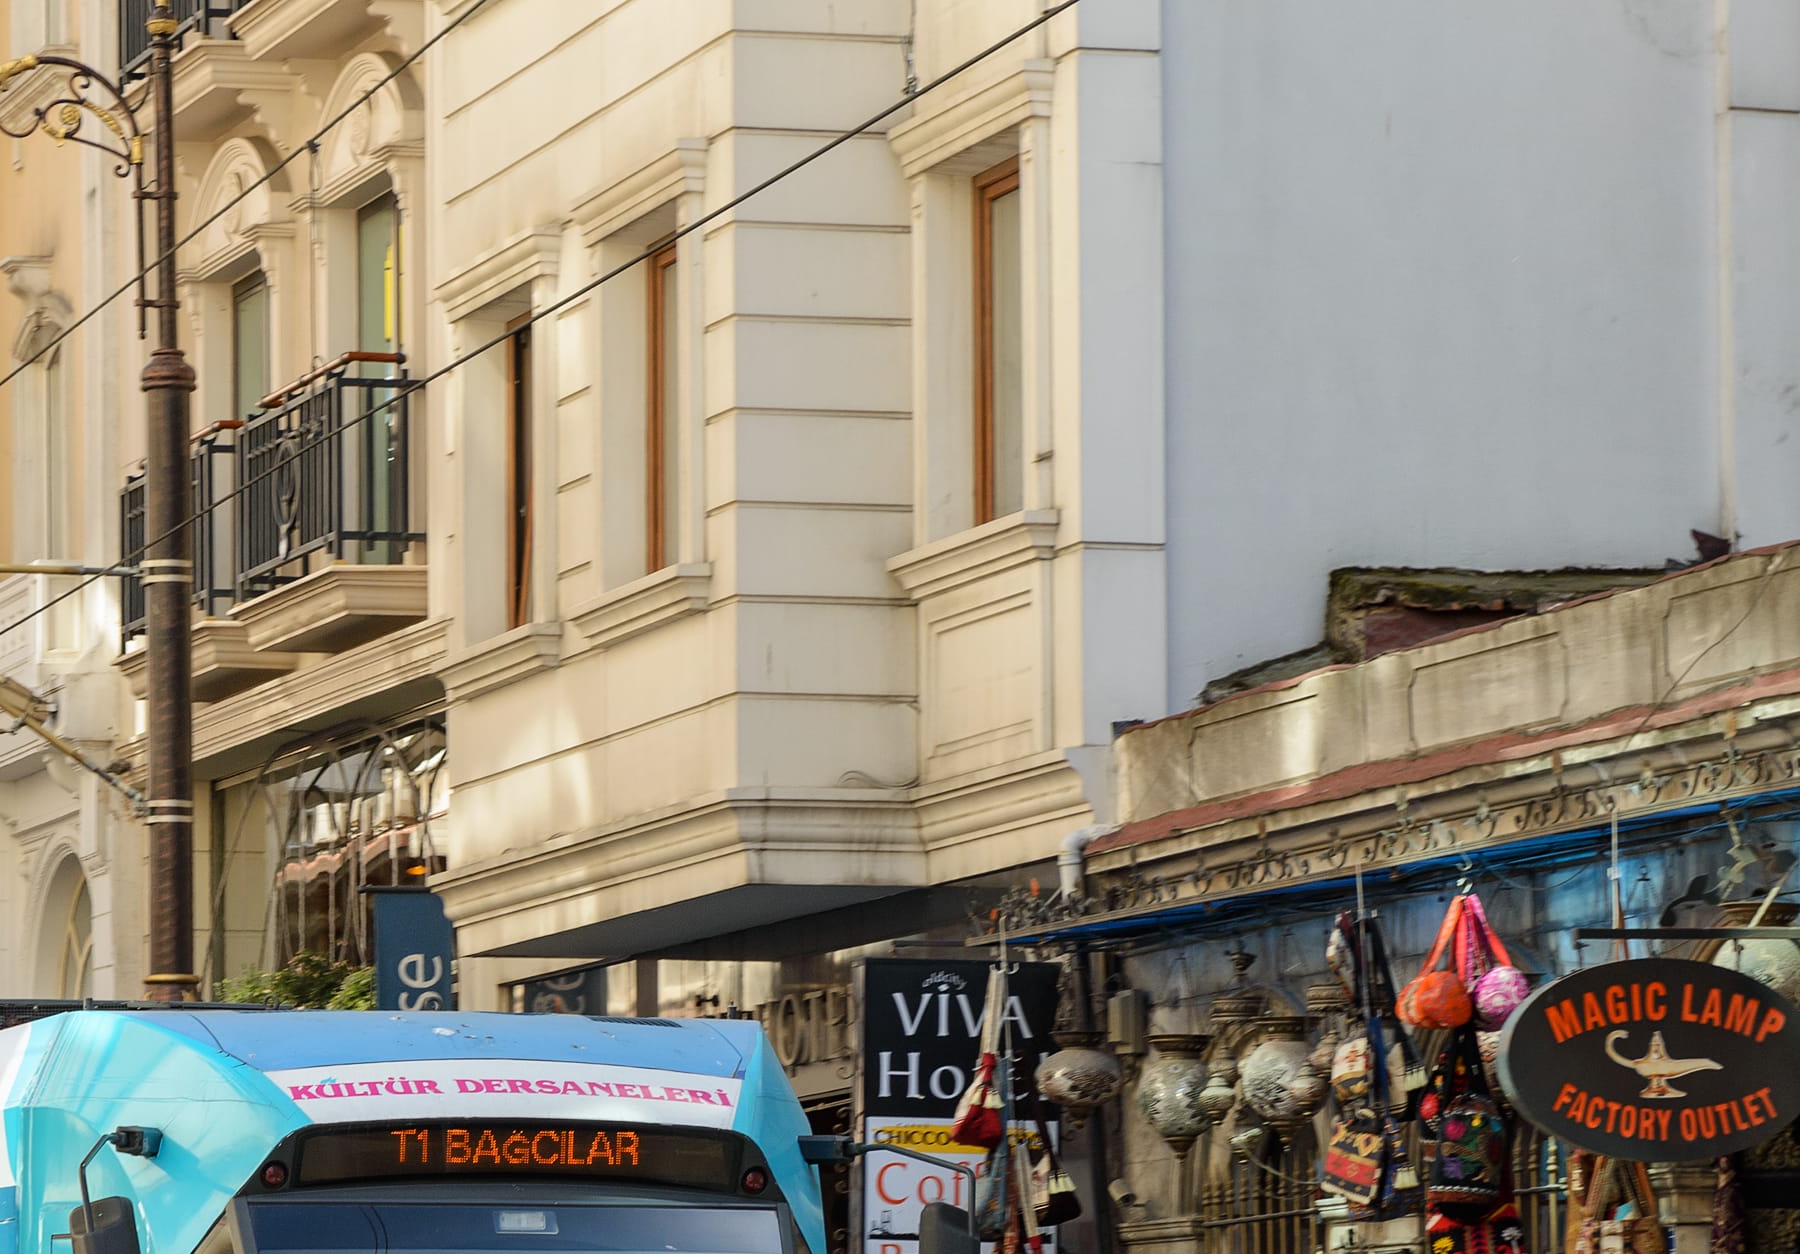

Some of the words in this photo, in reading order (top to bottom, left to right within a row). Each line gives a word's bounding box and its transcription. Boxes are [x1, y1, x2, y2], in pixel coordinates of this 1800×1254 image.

[1544, 981, 1668, 1044] MAGIC
[1680, 983, 1787, 1043] LAMP
[455, 1078, 734, 1107] DERSANELERİ
[1552, 1083, 1673, 1142] FACTORY
[1679, 1087, 1778, 1142] OUTLET
[390, 1129, 429, 1163] T1
[446, 1129, 640, 1166] BAĞCILAR
[873, 1128, 952, 1147] CHICCO
